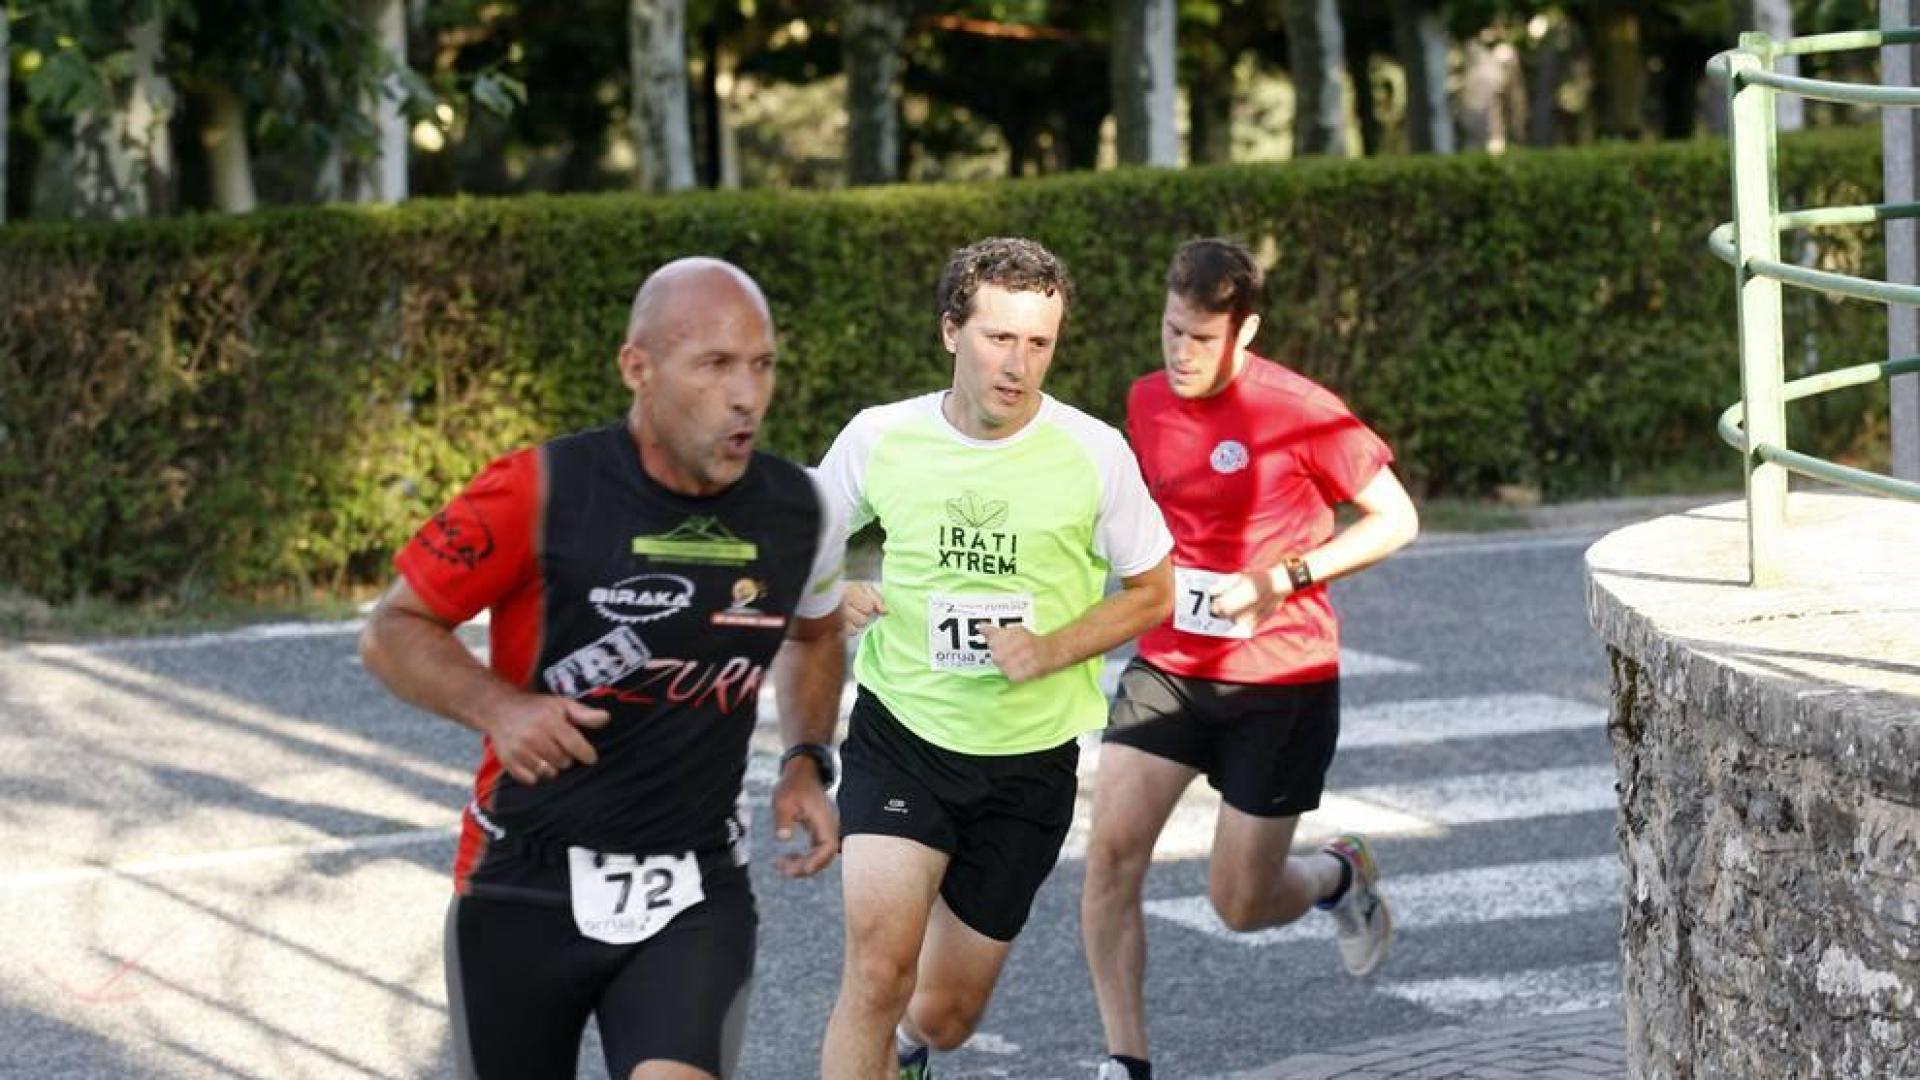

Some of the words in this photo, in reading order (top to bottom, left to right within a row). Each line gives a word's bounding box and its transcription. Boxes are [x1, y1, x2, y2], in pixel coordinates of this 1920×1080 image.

[939, 526, 1016, 554] IRATI
[939, 549, 1017, 575] XTREM
[589, 587, 692, 607] BIRAKA
[605, 868, 673, 915] 72
